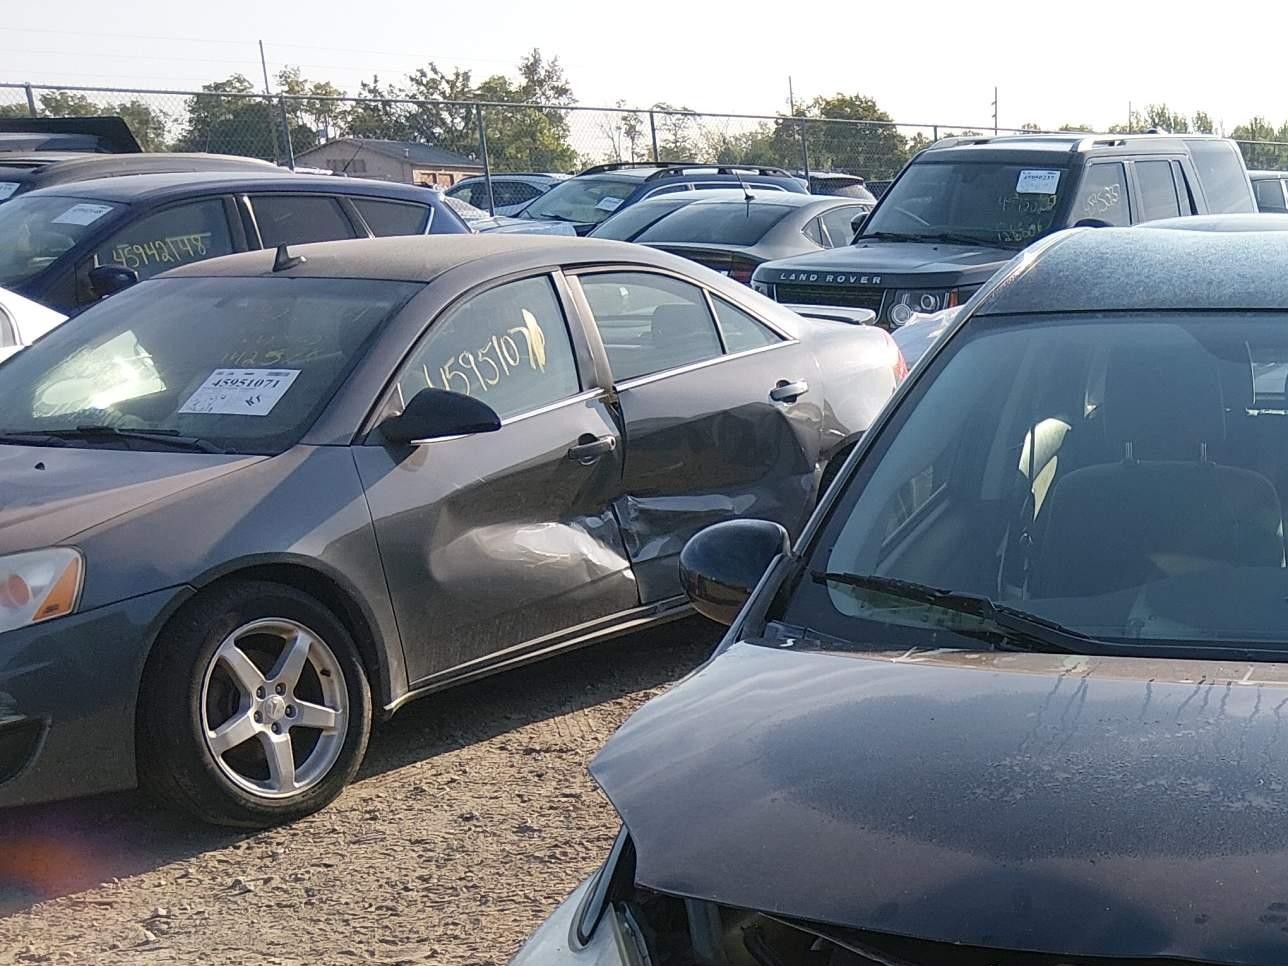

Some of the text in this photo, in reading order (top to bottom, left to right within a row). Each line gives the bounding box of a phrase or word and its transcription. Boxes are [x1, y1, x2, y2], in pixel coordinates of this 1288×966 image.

[780, 273, 881, 284] LAND ROVER
[212, 378, 280, 388] 45951071
